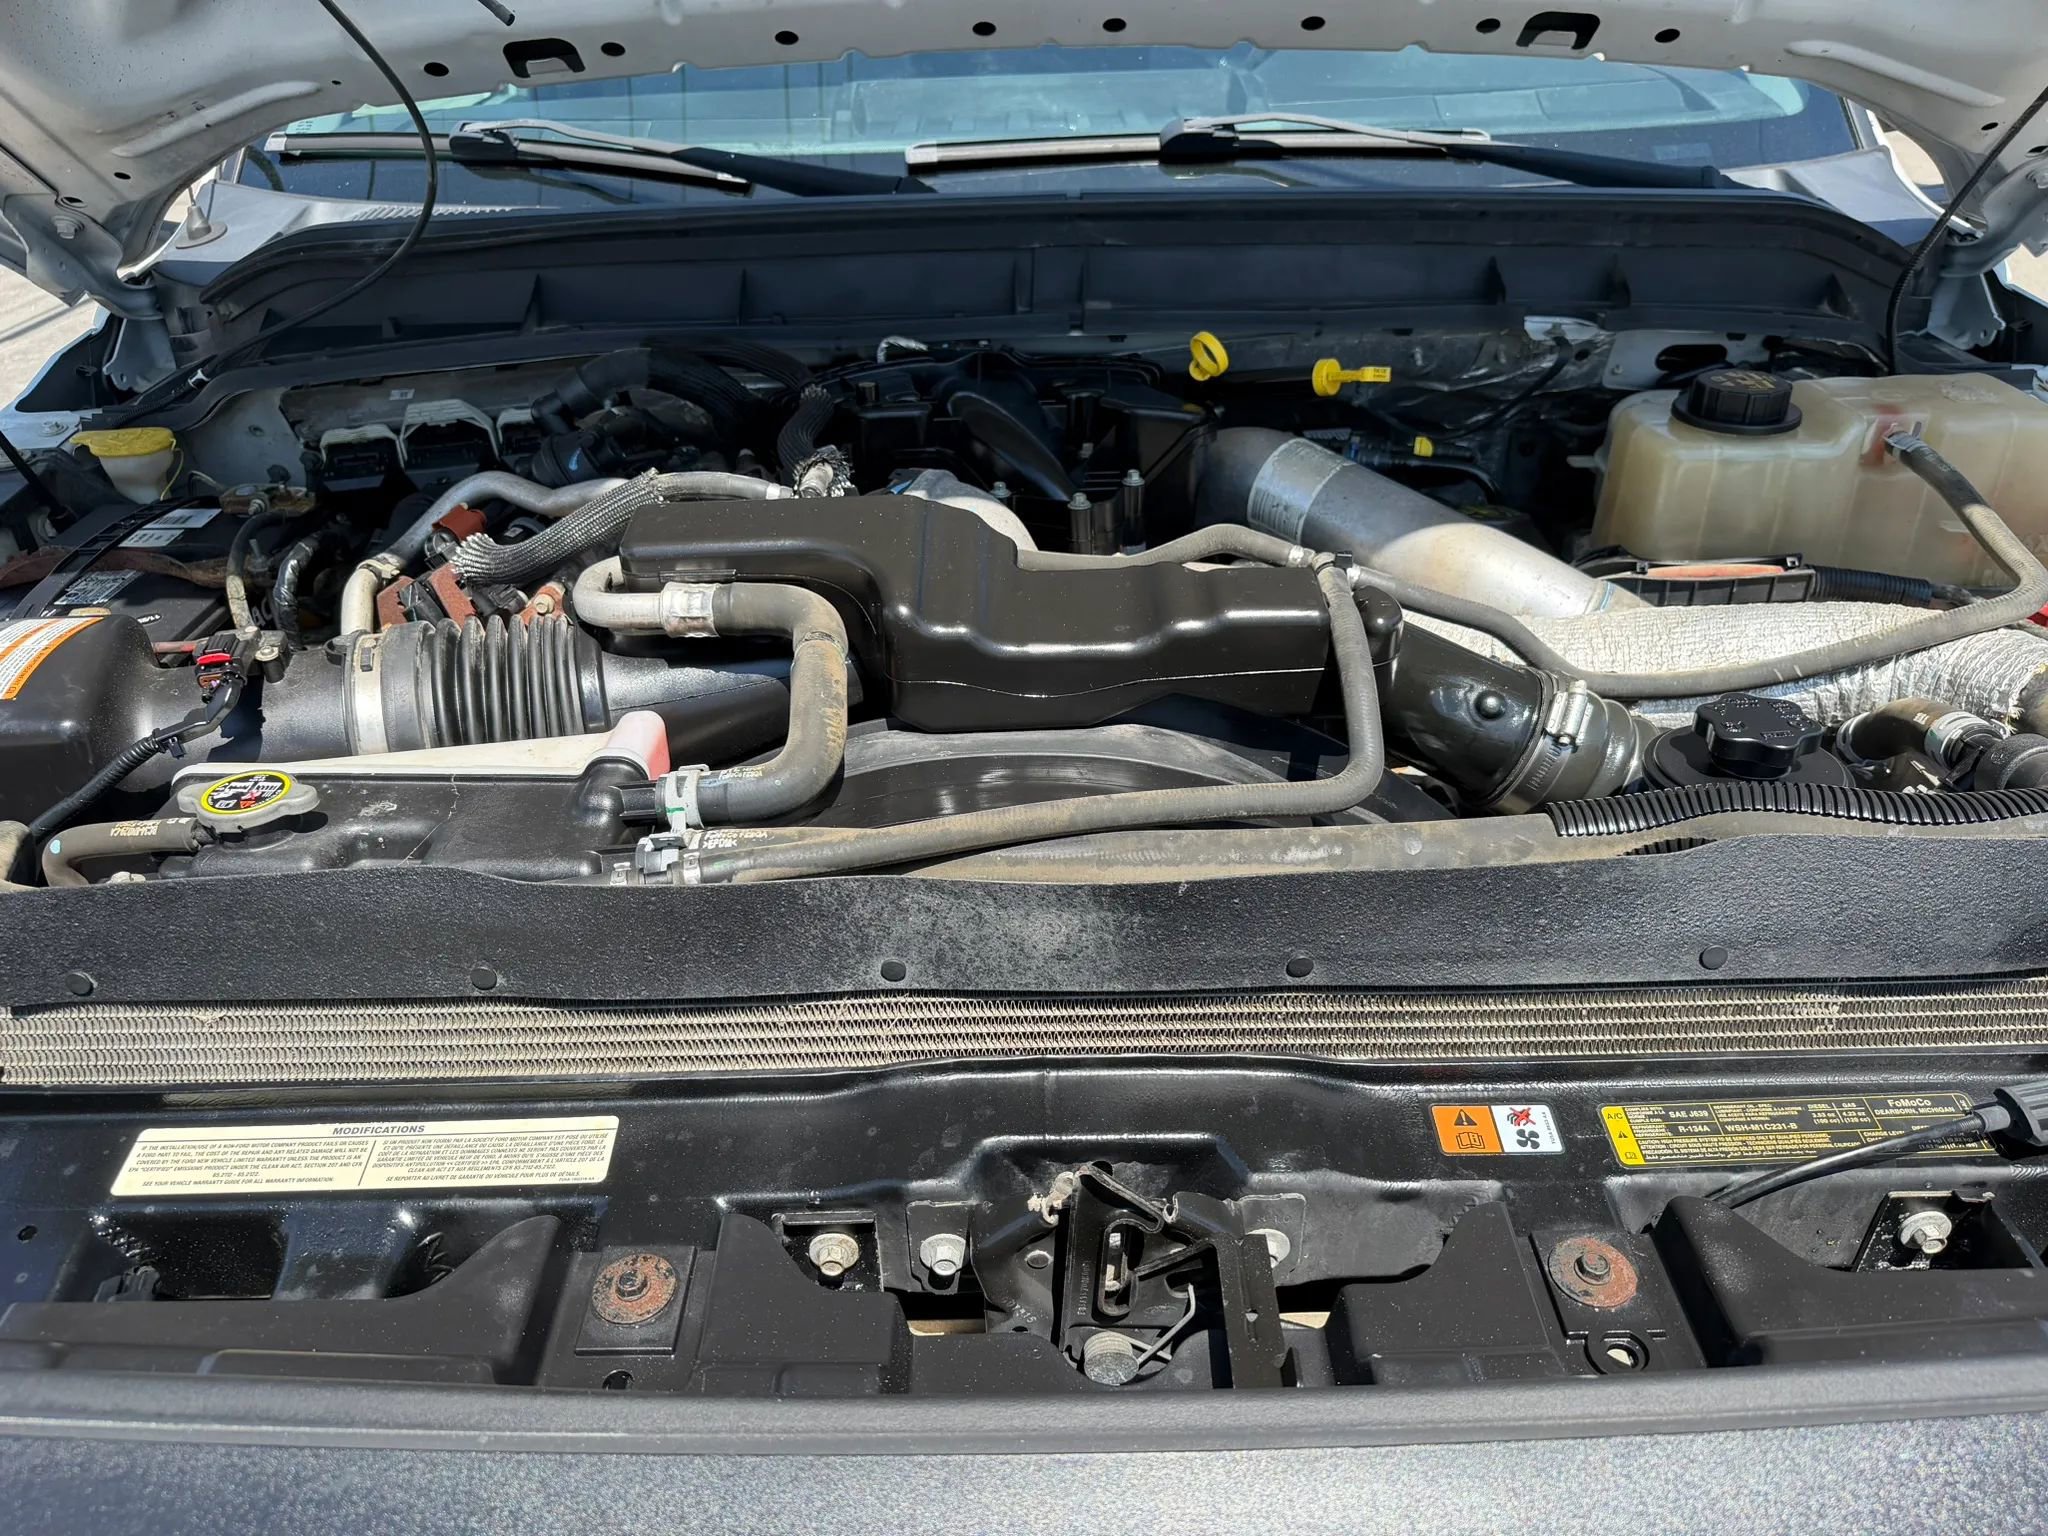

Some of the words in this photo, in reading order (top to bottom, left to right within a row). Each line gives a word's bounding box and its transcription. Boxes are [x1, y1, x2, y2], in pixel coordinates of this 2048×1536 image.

[1888, 1098, 1932, 1107] FoMoCo
[332, 1126, 425, 1135] MODIFICATIONS
[1726, 1123, 1798, 1132] WSH-M1C231-B
